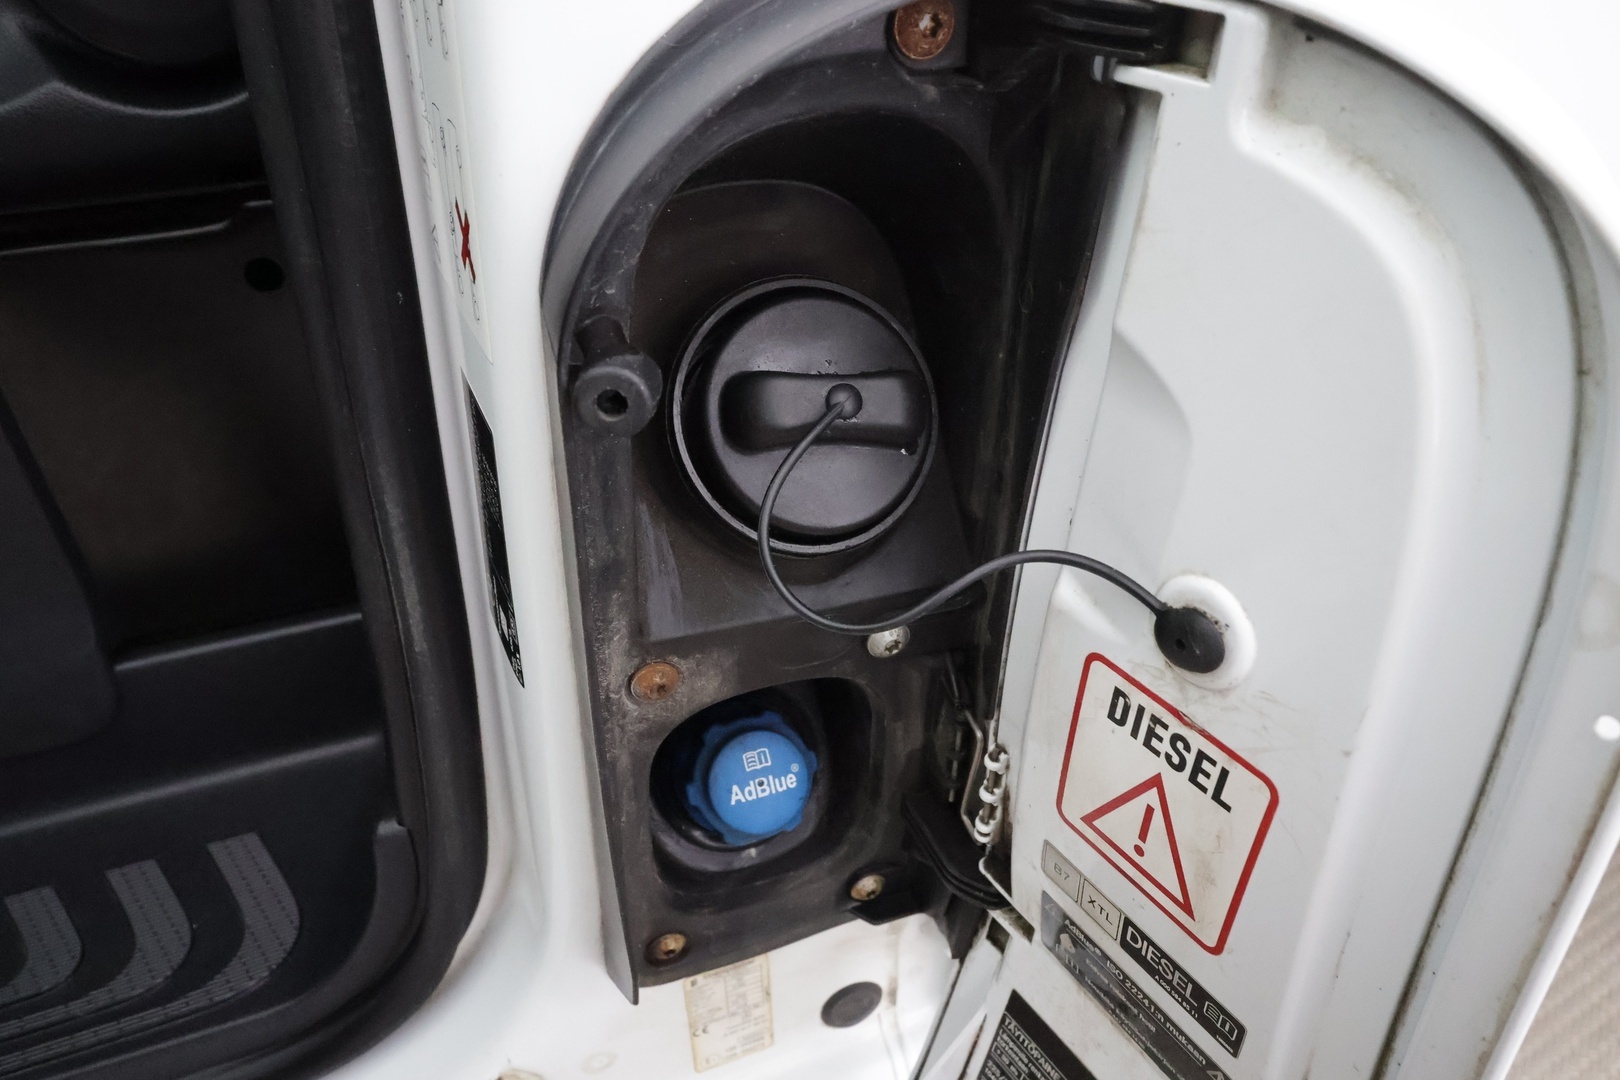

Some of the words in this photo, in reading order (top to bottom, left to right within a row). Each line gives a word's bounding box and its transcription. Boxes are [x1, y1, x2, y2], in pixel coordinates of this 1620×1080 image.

[1107, 685, 1232, 814] DIESEL
[1053, 862, 1071, 881] B7
[1088, 894, 1113, 926] XTL
[1126, 925, 1198, 1007] DIESEL
[1106, 960, 1123, 980] ISO
[1165, 1021, 1206, 1065] mukaan
